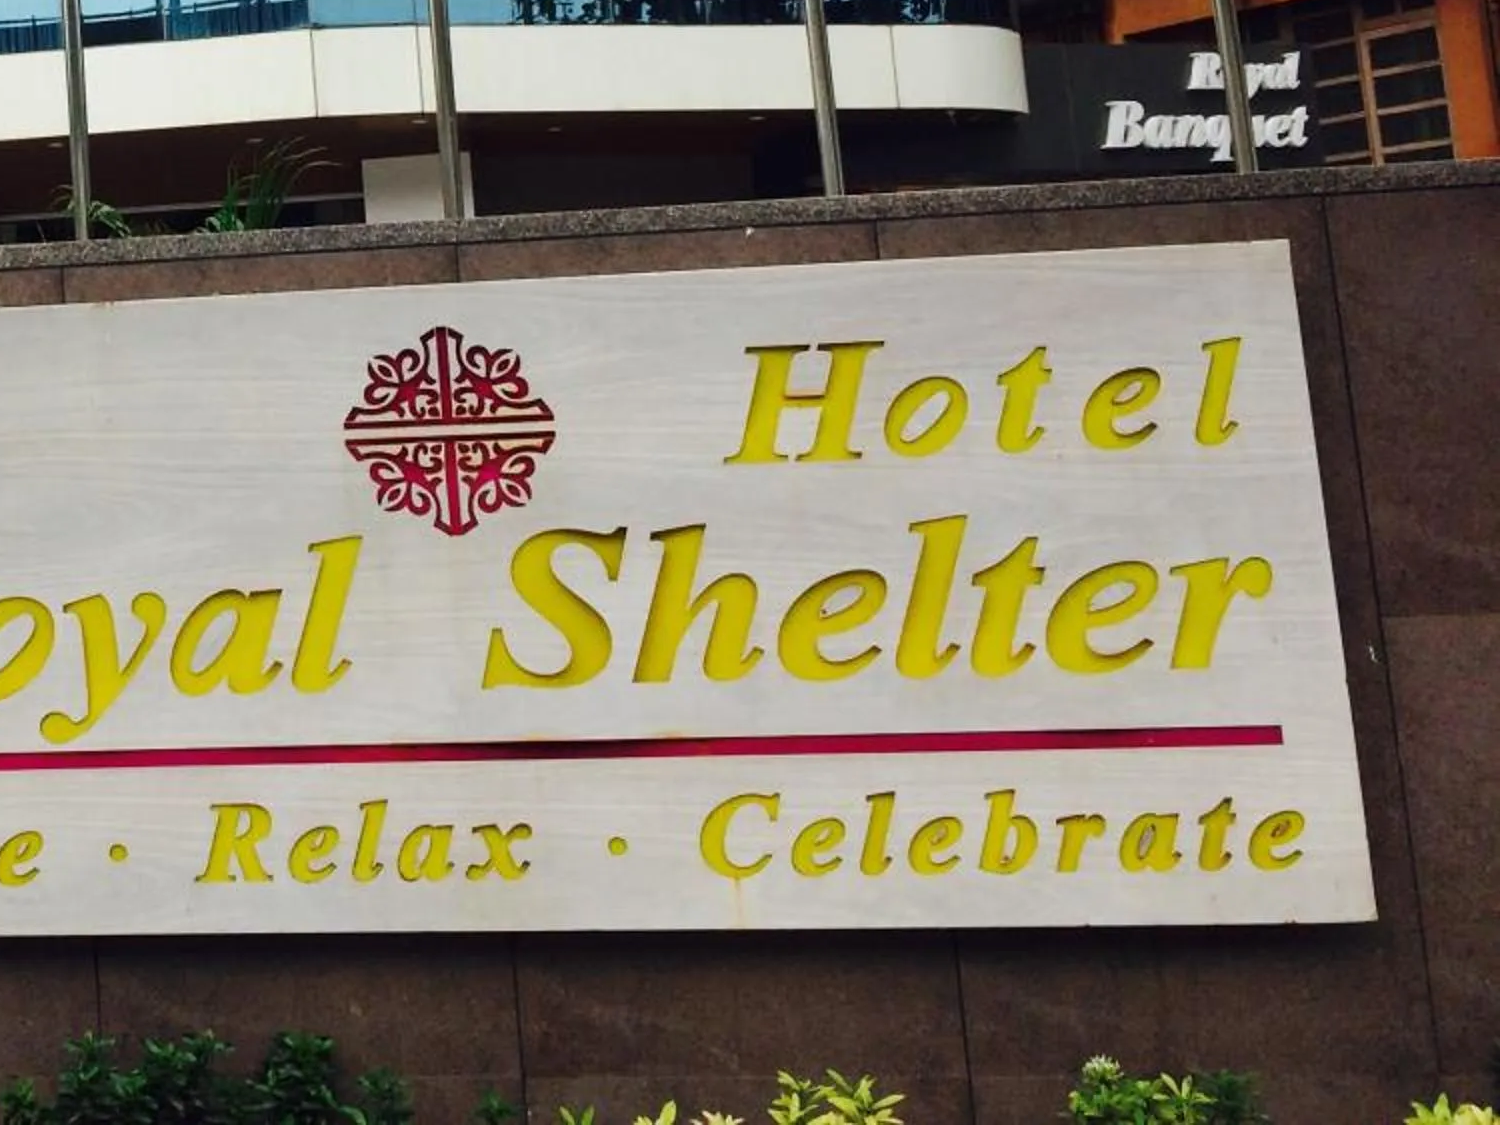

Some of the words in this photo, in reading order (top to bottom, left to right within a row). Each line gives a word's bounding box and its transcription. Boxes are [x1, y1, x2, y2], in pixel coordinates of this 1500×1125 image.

[1186, 50, 1301, 100] Ryal
[723, 336, 1243, 466] Hotel
[481, 514, 1274, 691] Shelter
[193, 798, 536, 885] Relax
[700, 788, 1306, 877] Celebrate
